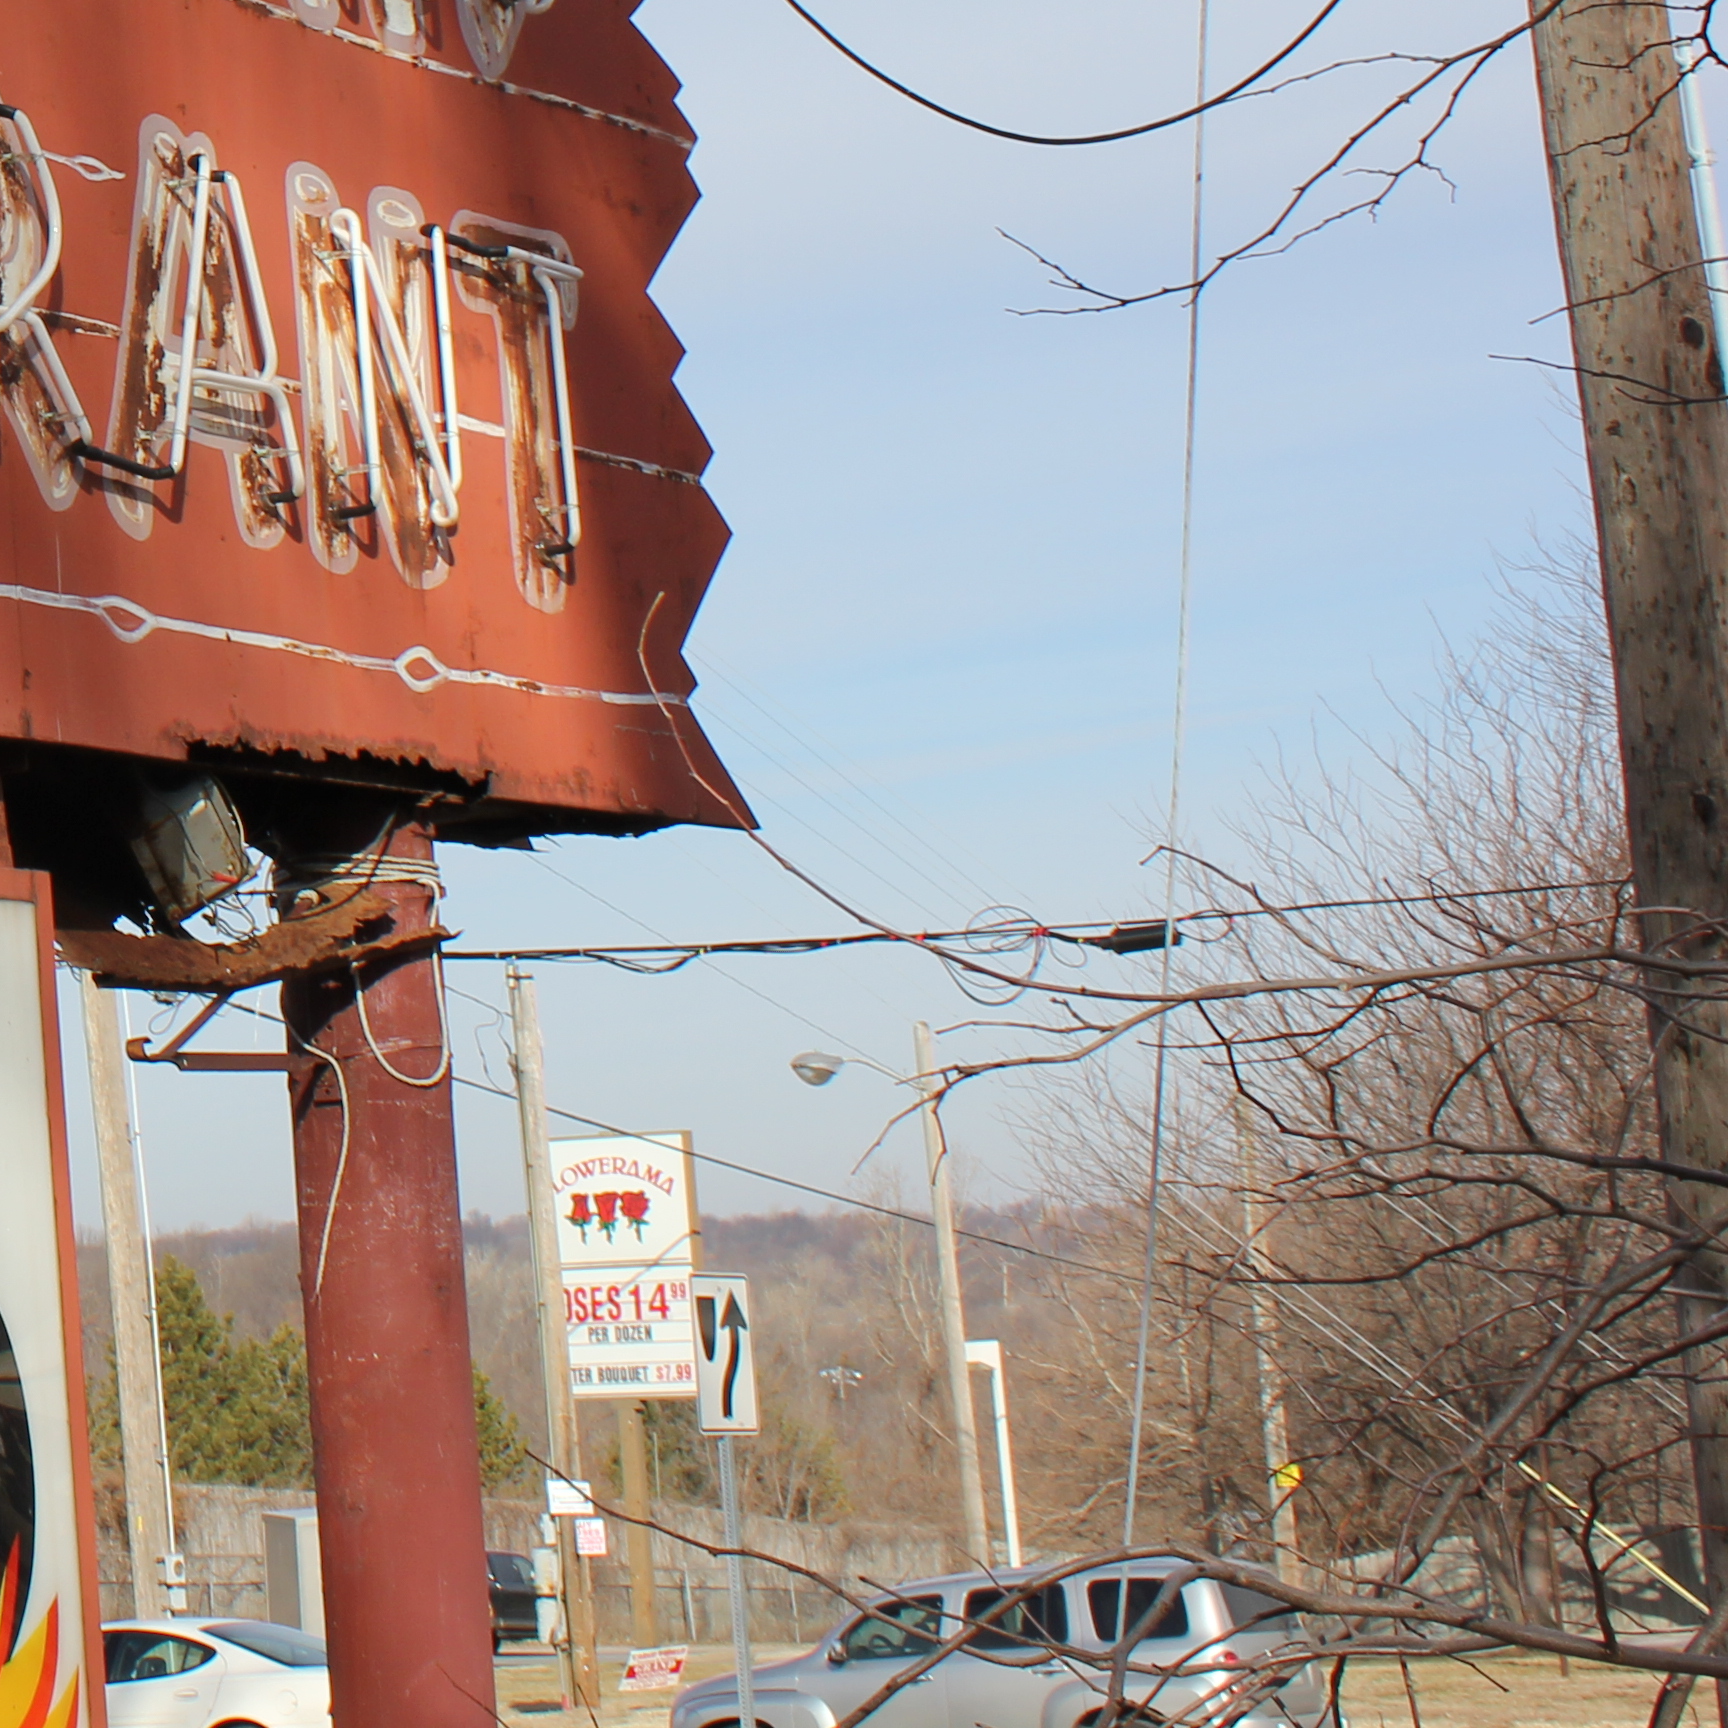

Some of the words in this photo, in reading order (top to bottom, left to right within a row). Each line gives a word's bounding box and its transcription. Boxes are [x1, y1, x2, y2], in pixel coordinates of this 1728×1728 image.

[552, 1157, 674, 1196] LOWERAMA
[563, 1285, 622, 1322] OSES
[588, 1325, 609, 1342] PER
[615, 1324, 653, 1342] DOZEN
[571, 1367, 592, 1383] TER
[597, 1365, 649, 1383] BOUQUET
[656, 1364, 693, 1382] $7.99
